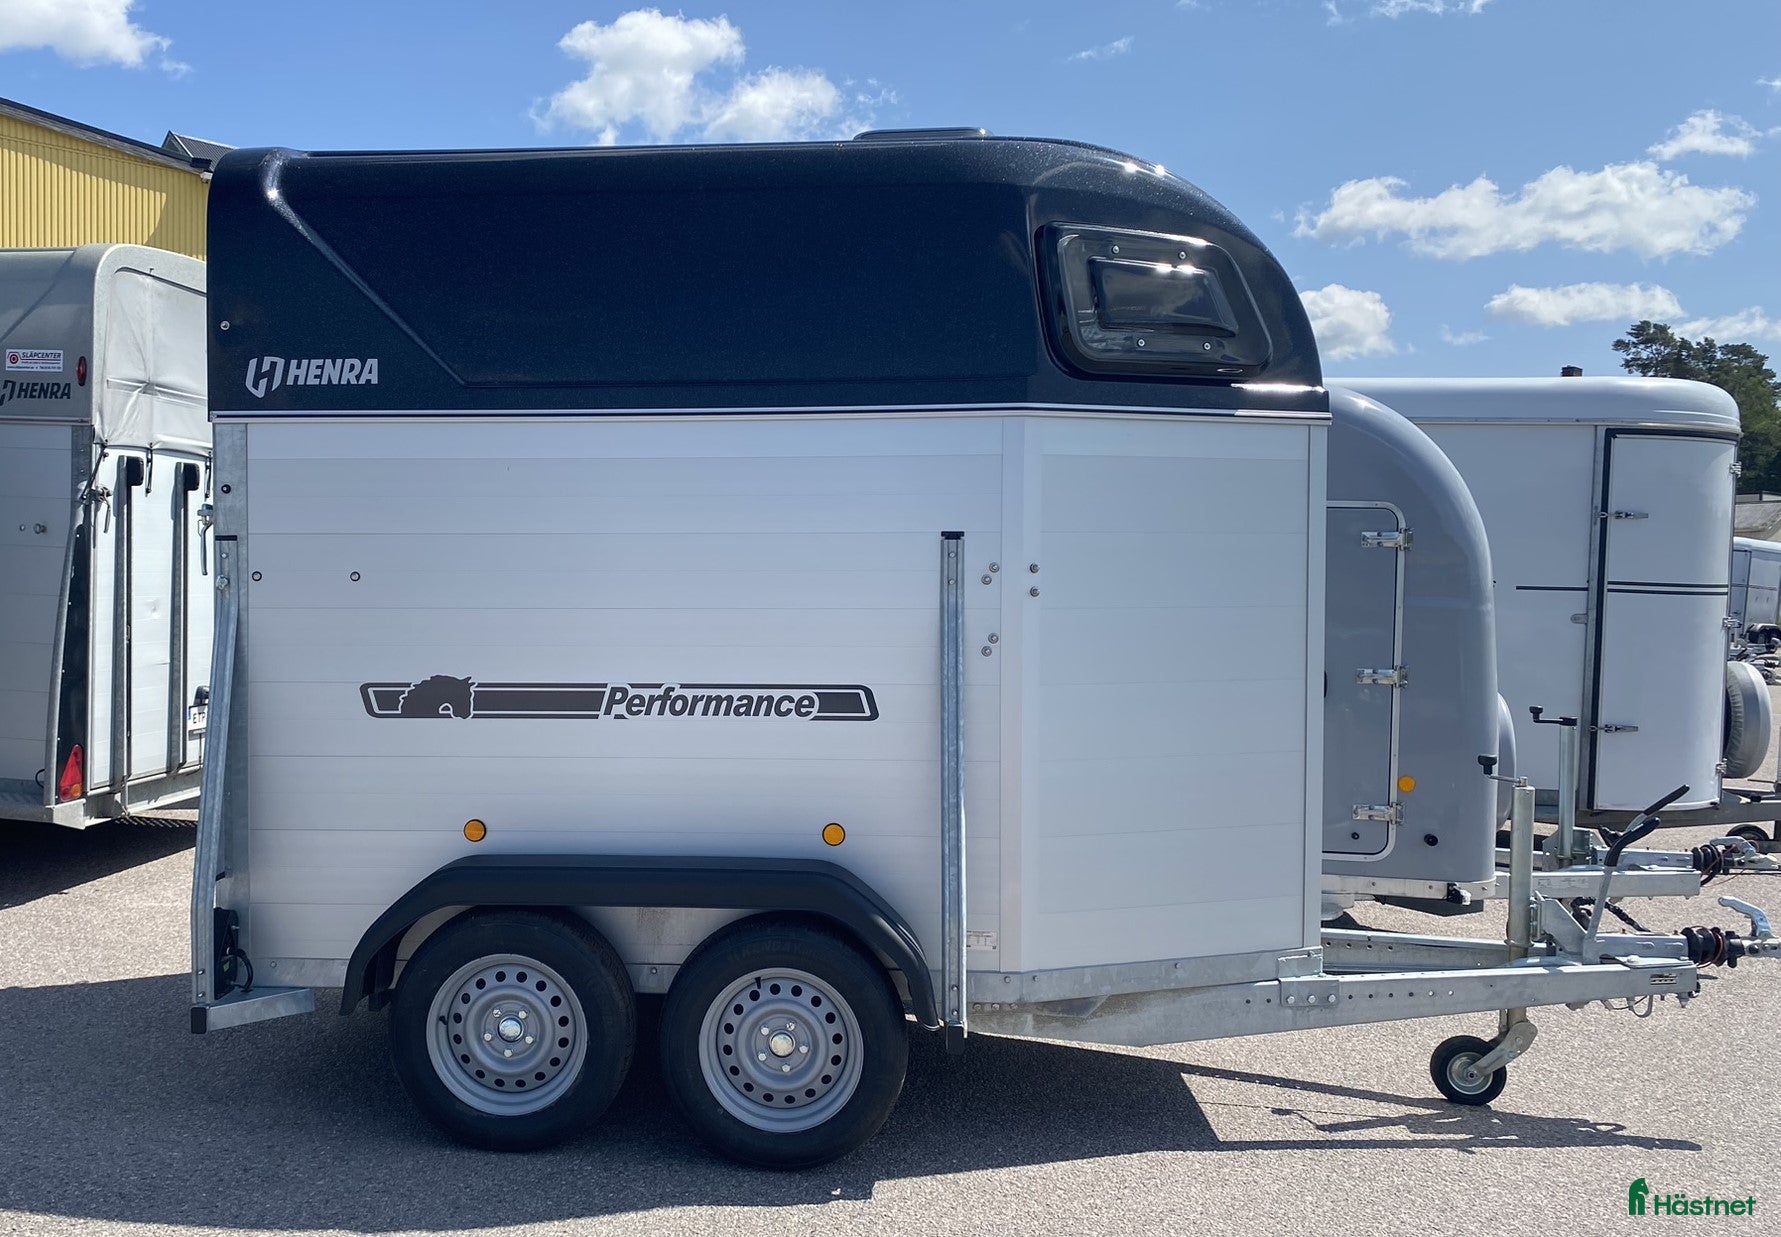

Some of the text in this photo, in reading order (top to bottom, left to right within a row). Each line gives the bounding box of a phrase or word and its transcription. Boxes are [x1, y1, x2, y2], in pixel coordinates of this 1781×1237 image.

[286, 358, 379, 386] HENRA
[17, 382, 71, 400] HENRA
[603, 686, 815, 717] Performance
